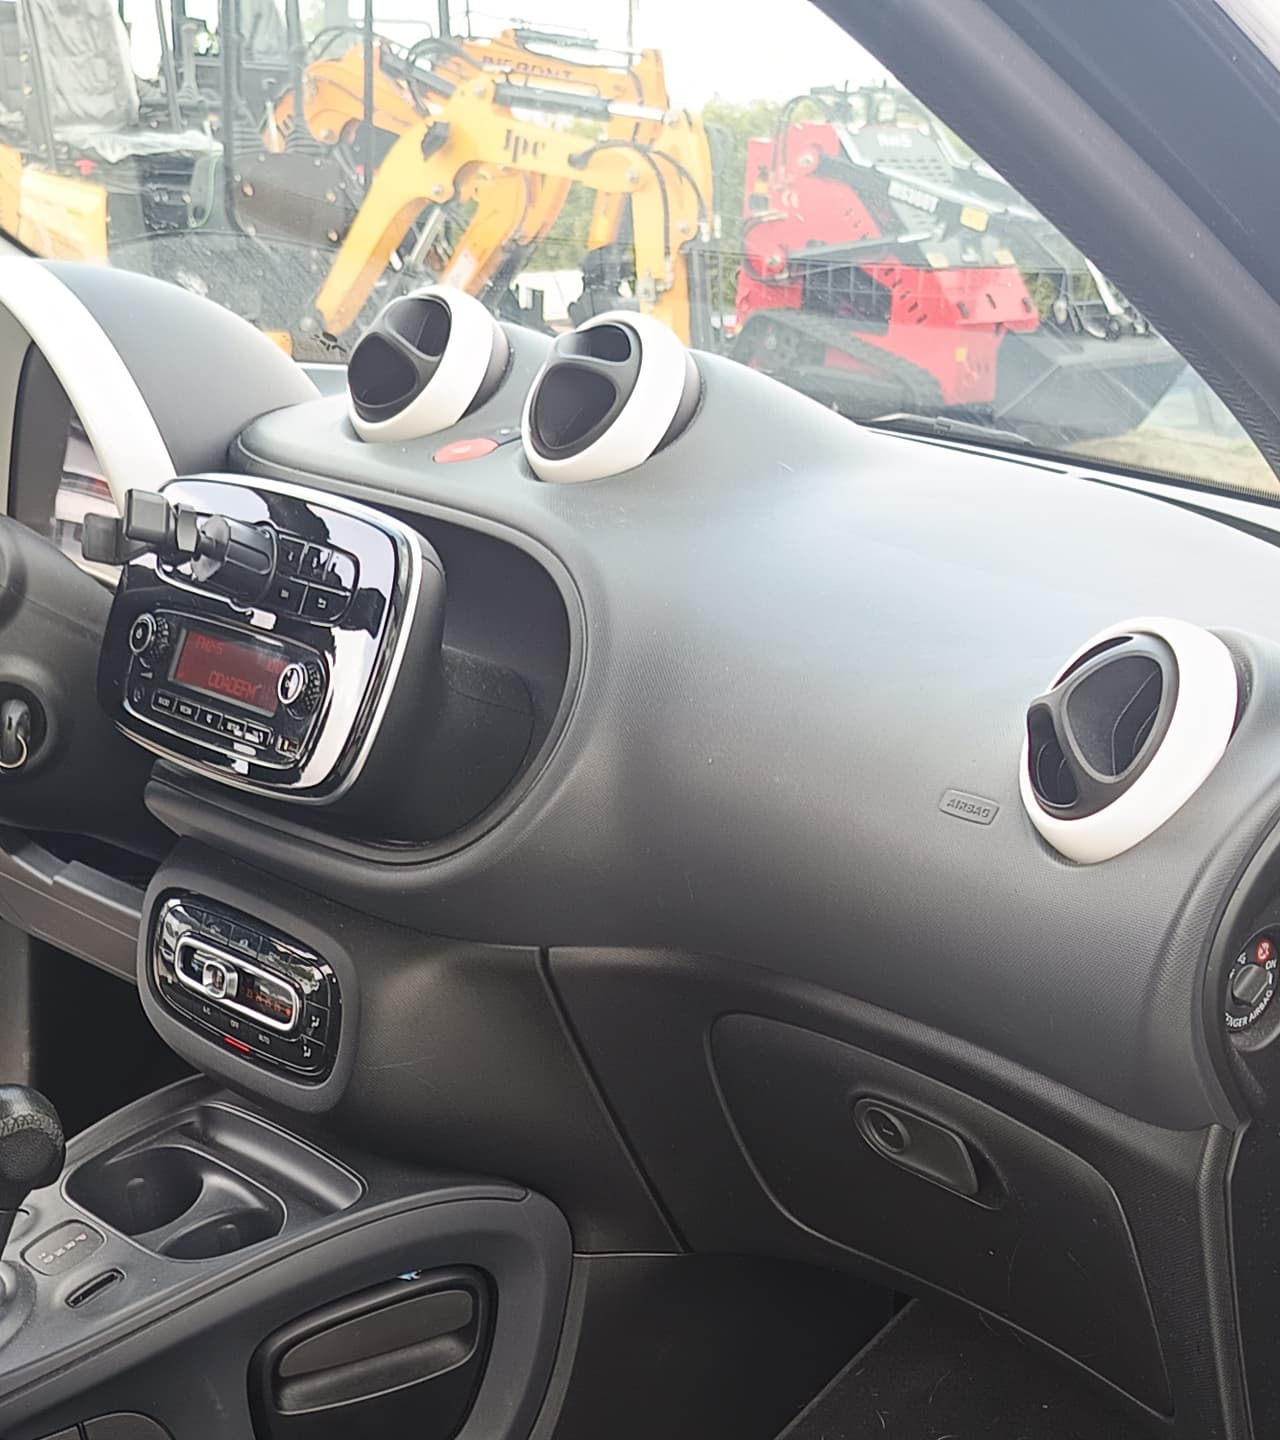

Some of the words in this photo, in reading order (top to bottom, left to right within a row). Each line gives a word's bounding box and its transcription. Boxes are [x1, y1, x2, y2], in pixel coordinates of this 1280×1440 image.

[946, 798, 990, 818] AIRBAG
[1265, 959, 1277, 970] ON
[1248, 989, 1273, 1022] AIRBAG
